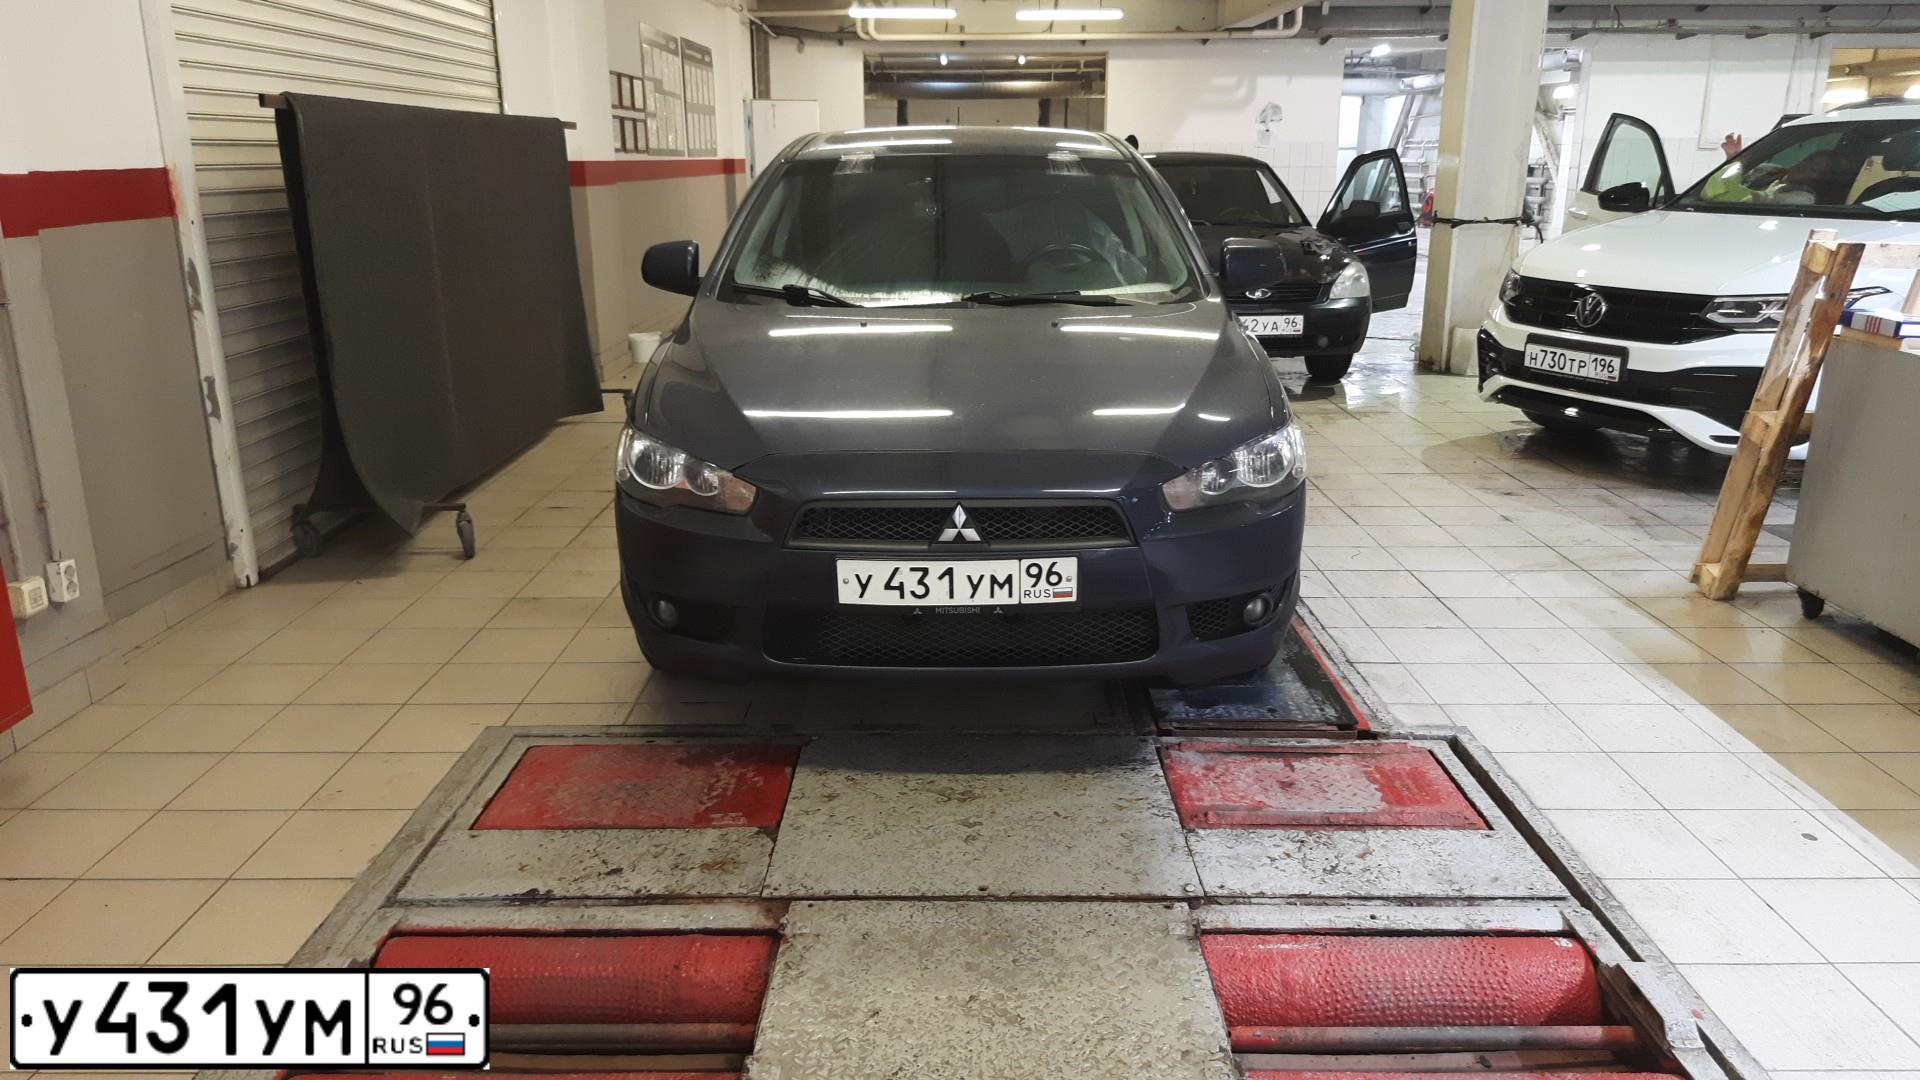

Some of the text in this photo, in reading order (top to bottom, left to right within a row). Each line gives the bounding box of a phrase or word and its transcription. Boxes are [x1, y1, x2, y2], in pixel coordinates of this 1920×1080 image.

[1591, 357, 1615, 373] 196
[1025, 561, 1063, 588] 96
[1023, 588, 1052, 599] RUS
[935, 606, 981, 614] MITSUBISHI
